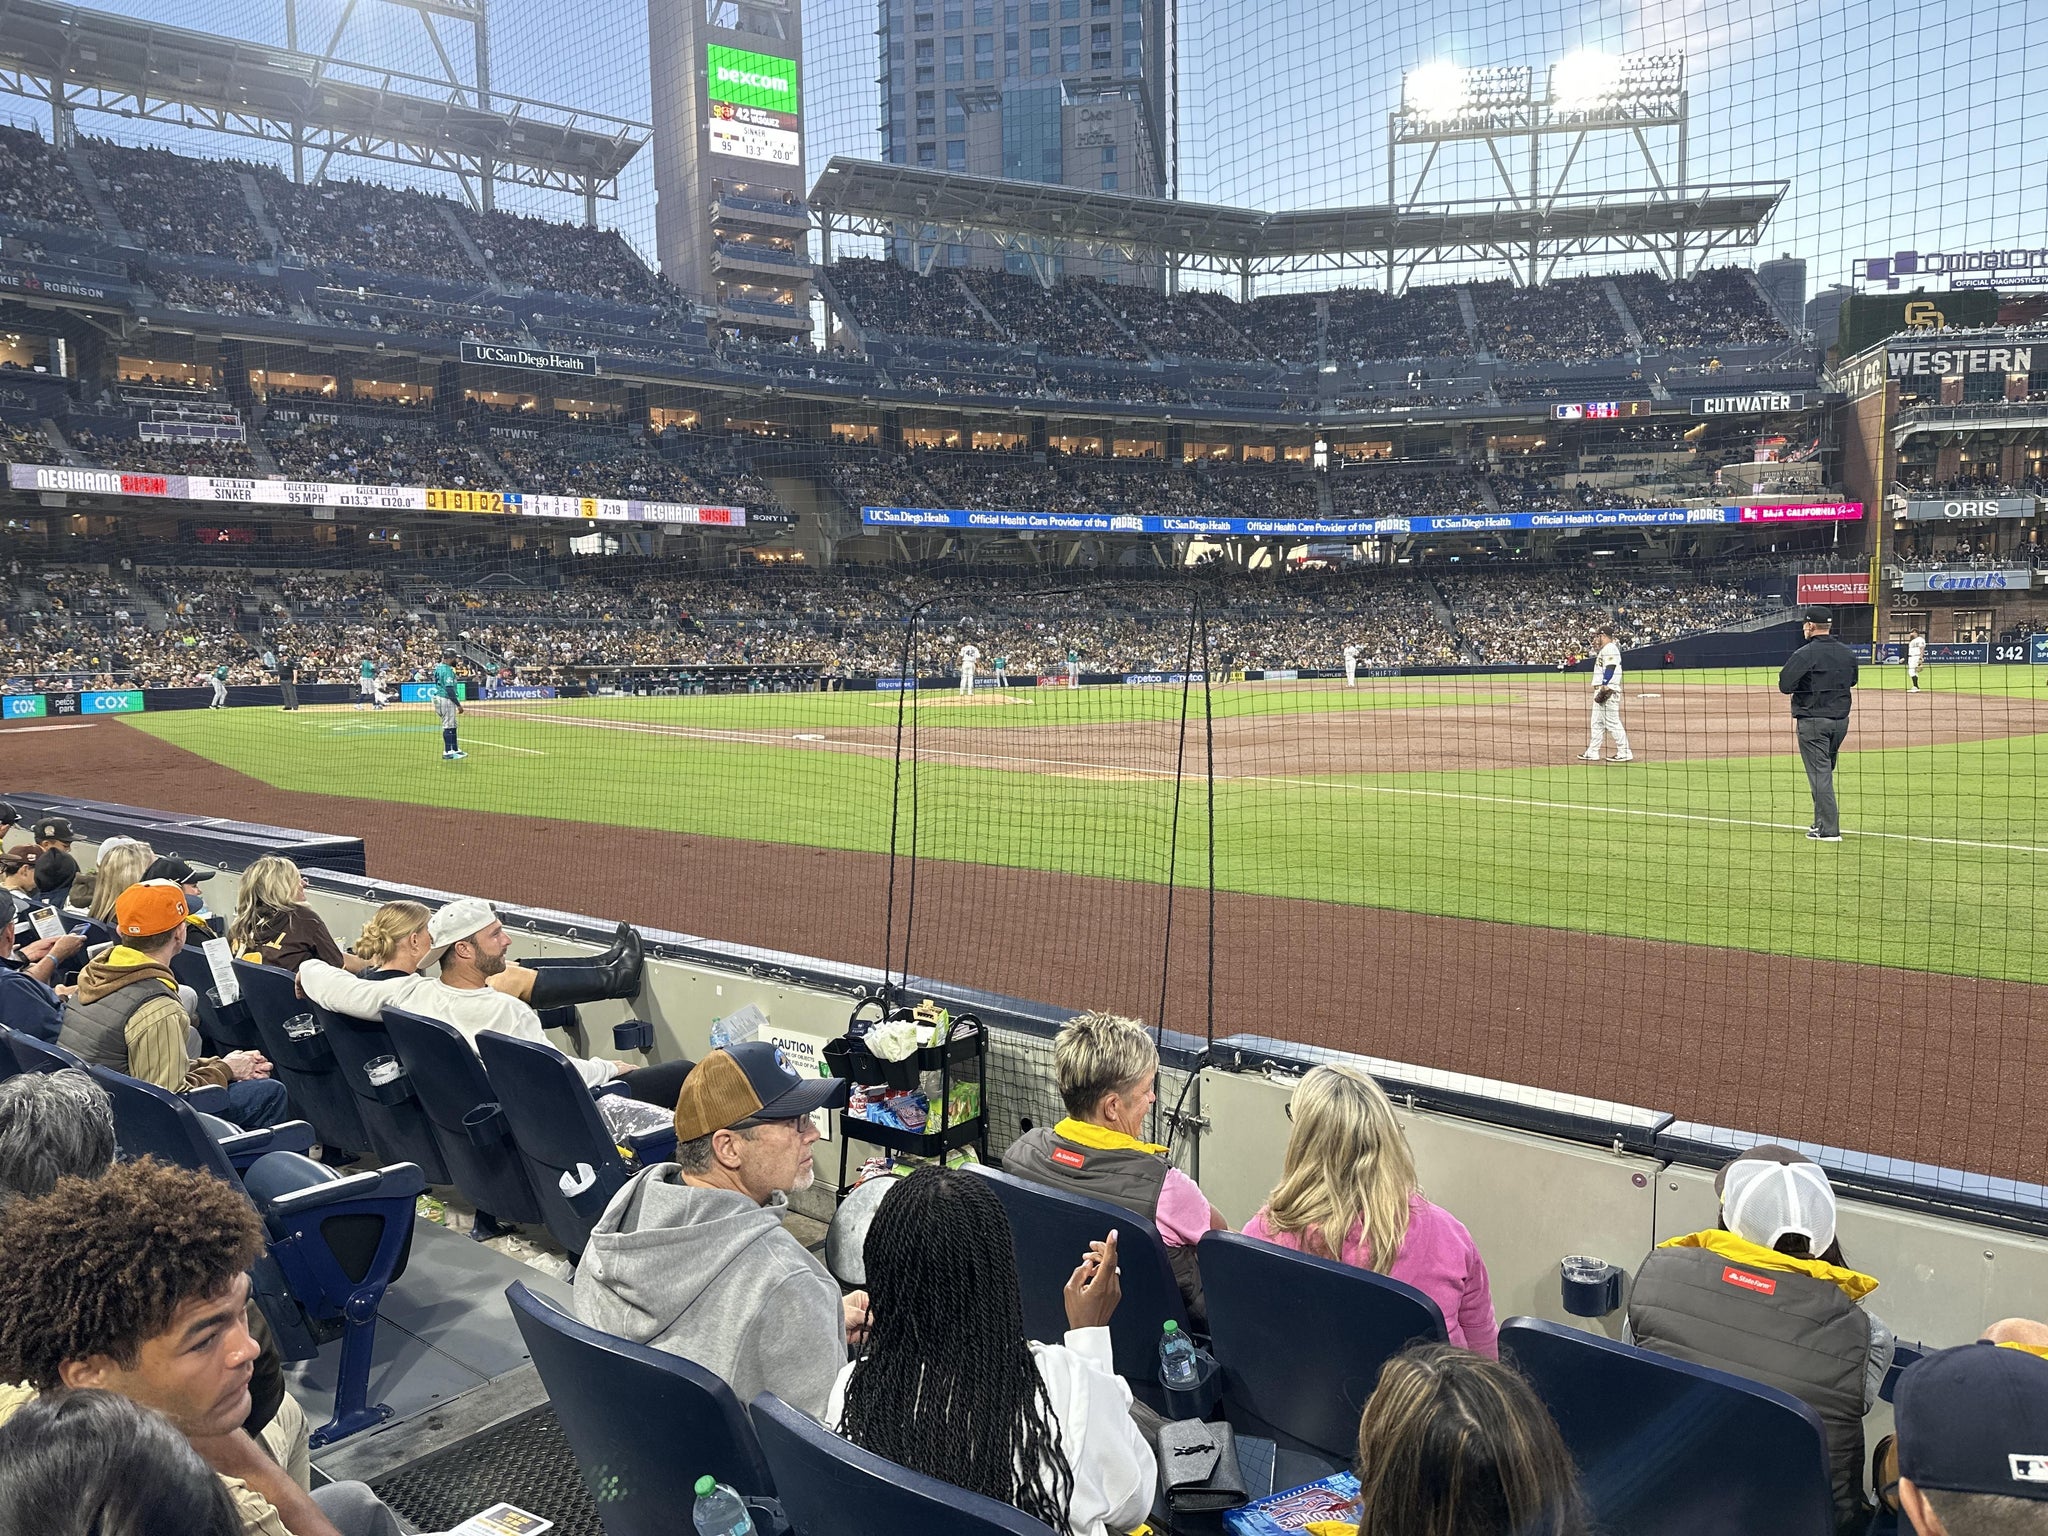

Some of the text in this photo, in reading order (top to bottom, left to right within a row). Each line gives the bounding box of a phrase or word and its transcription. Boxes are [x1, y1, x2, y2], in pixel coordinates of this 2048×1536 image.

[736, 107, 749, 121] 42
[744, 127, 766, 137] SINKER
[722, 141, 732, 151] 95
[1078, 133, 1114, 146] HOTEL
[1991, 277, 2040, 285] DIAGNOSTICS
[24, 278, 40, 289] 42
[43, 282, 104, 298] ROBINSON
[476, 347, 584, 370] UC San Diego Health
[1888, 347, 2032, 375] WESTERN
[1631, 403, 1638, 414] F
[1704, 395, 1790, 413] CUTWATER
[274, 410, 338, 425] CUTATER
[489, 427, 540, 440] CUTWATE
[215, 488, 252, 500] SINKER
[288, 492, 325, 504] 95 MPH
[441, 491, 447, 508] 1
[467, 493, 473, 510] 1
[491, 494, 501, 512] 2
[586, 504, 592, 517] 3
[603, 504, 621, 515] 7:19
[1763, 509, 1784, 518] BAJA
[1786, 507, 1836, 517] CALIFORNIA
[1944, 501, 1999, 518] ORIS
[753, 514, 777, 522] SONY
[870, 510, 1143, 531] UC San Diego Health Official Health Care Provider of the PADRES
[1432, 508, 1725, 529] UC San Diego Health Official Health Care Provider of the PADRES
[1163, 519, 1411, 533] UC San Diego Health Official Health Care Provider of the PADRES
[1812, 584, 1852, 592] MISSION
[1892, 594, 1919, 607] 336
[1995, 645, 2024, 661] 342
[1136, 673, 1161, 684] petco
[1178, 673, 1203, 682] ptco
[417, 687, 438, 698] CO
[12, 700, 36, 713] COX
[55, 698, 75, 707] petco
[59, 704, 75, 713] park
[95, 696, 128, 709] COX
[771, 1037, 814, 1055] CAUTION
[797, 1054, 815, 1063] OBJECTS
